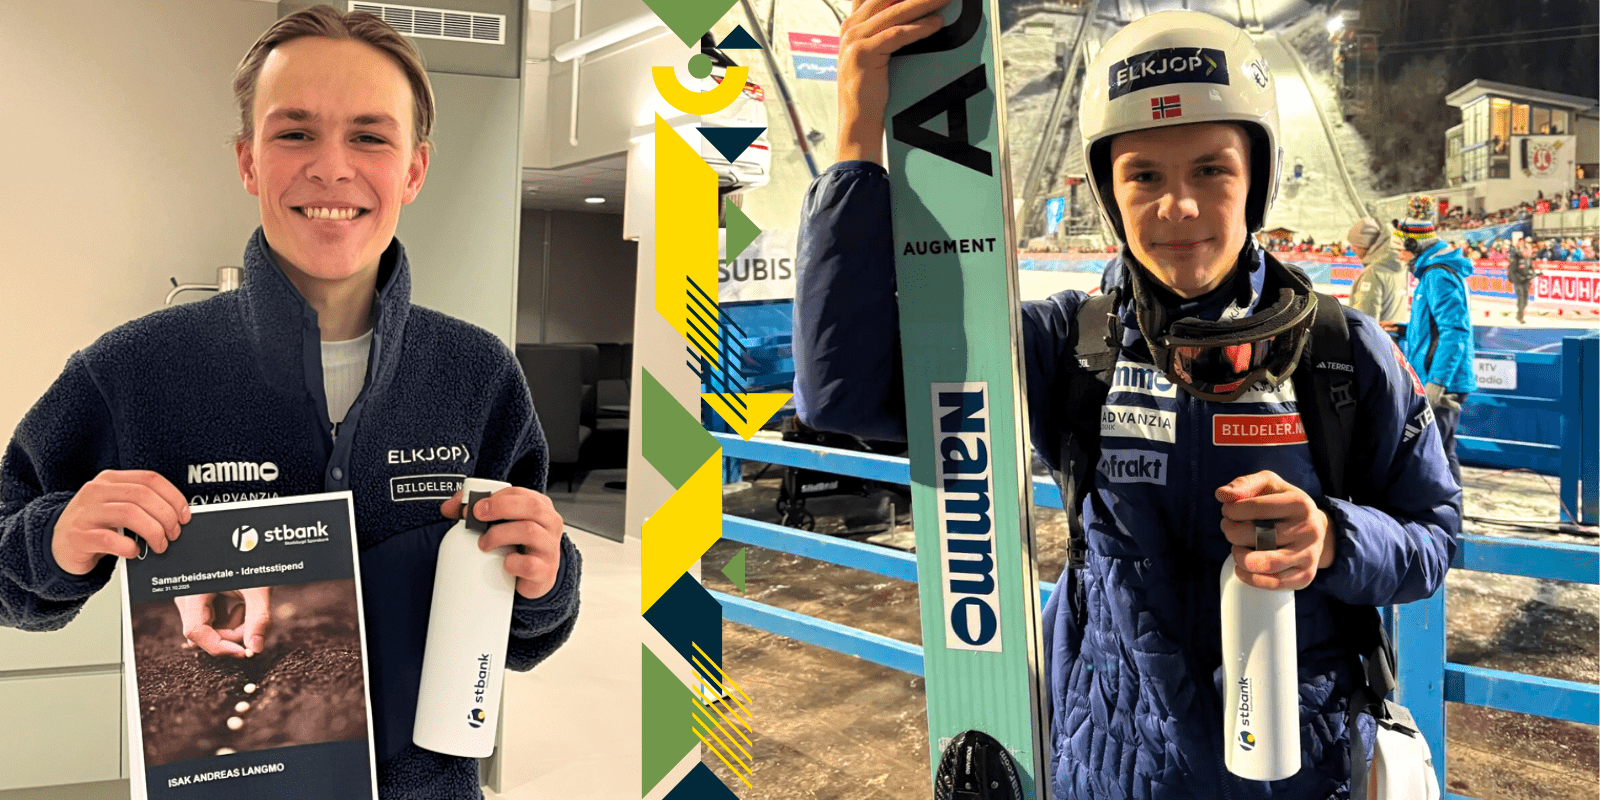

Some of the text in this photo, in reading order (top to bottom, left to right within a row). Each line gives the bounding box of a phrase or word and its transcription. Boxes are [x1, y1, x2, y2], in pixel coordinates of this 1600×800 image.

[903, 237, 997, 256] AUGMENT
[718, 258, 797, 283] SUBIS
[1327, 361, 1355, 372] TERREX
[1478, 363, 1497, 372] RTV
[1101, 411, 1172, 429] ADVANZIA
[212, 491, 279, 503] ADVANZIA
[264, 521, 329, 542] stbank
[151, 568, 234, 586] Samarbeidsavtale
[241, 560, 304, 576] Idrettsstipend
[473, 653, 490, 703] stbank
[1238, 676, 1250, 726] stbank
[168, 762, 285, 788] ISAK ANDREAS LANGMO
